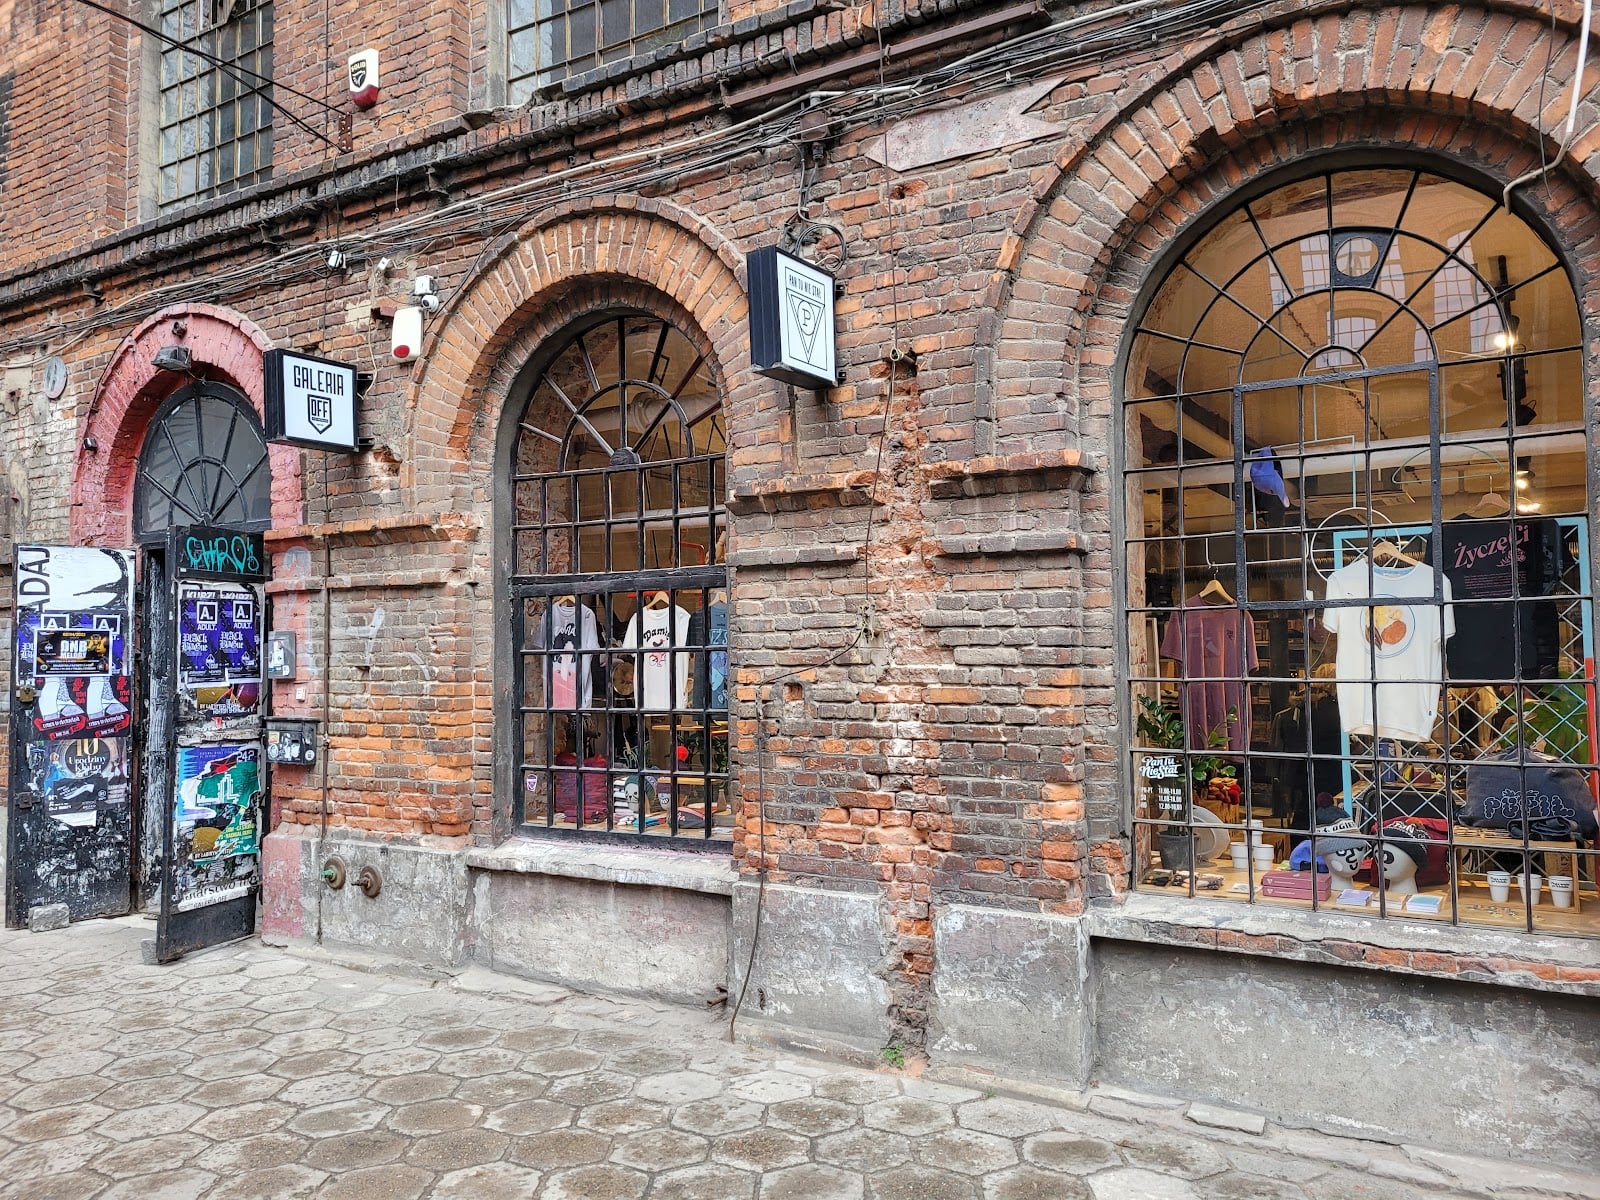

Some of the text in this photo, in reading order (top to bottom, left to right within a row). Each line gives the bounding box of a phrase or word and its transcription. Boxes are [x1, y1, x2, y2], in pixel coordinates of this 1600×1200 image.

[802, 308, 811, 327] P
[293, 364, 344, 396] GALERIA
[310, 398, 329, 418] OFF
[1454, 536, 1509, 569] Życzę
[60, 639, 88, 653] DNB
[68, 755, 106, 765] Urodziny
